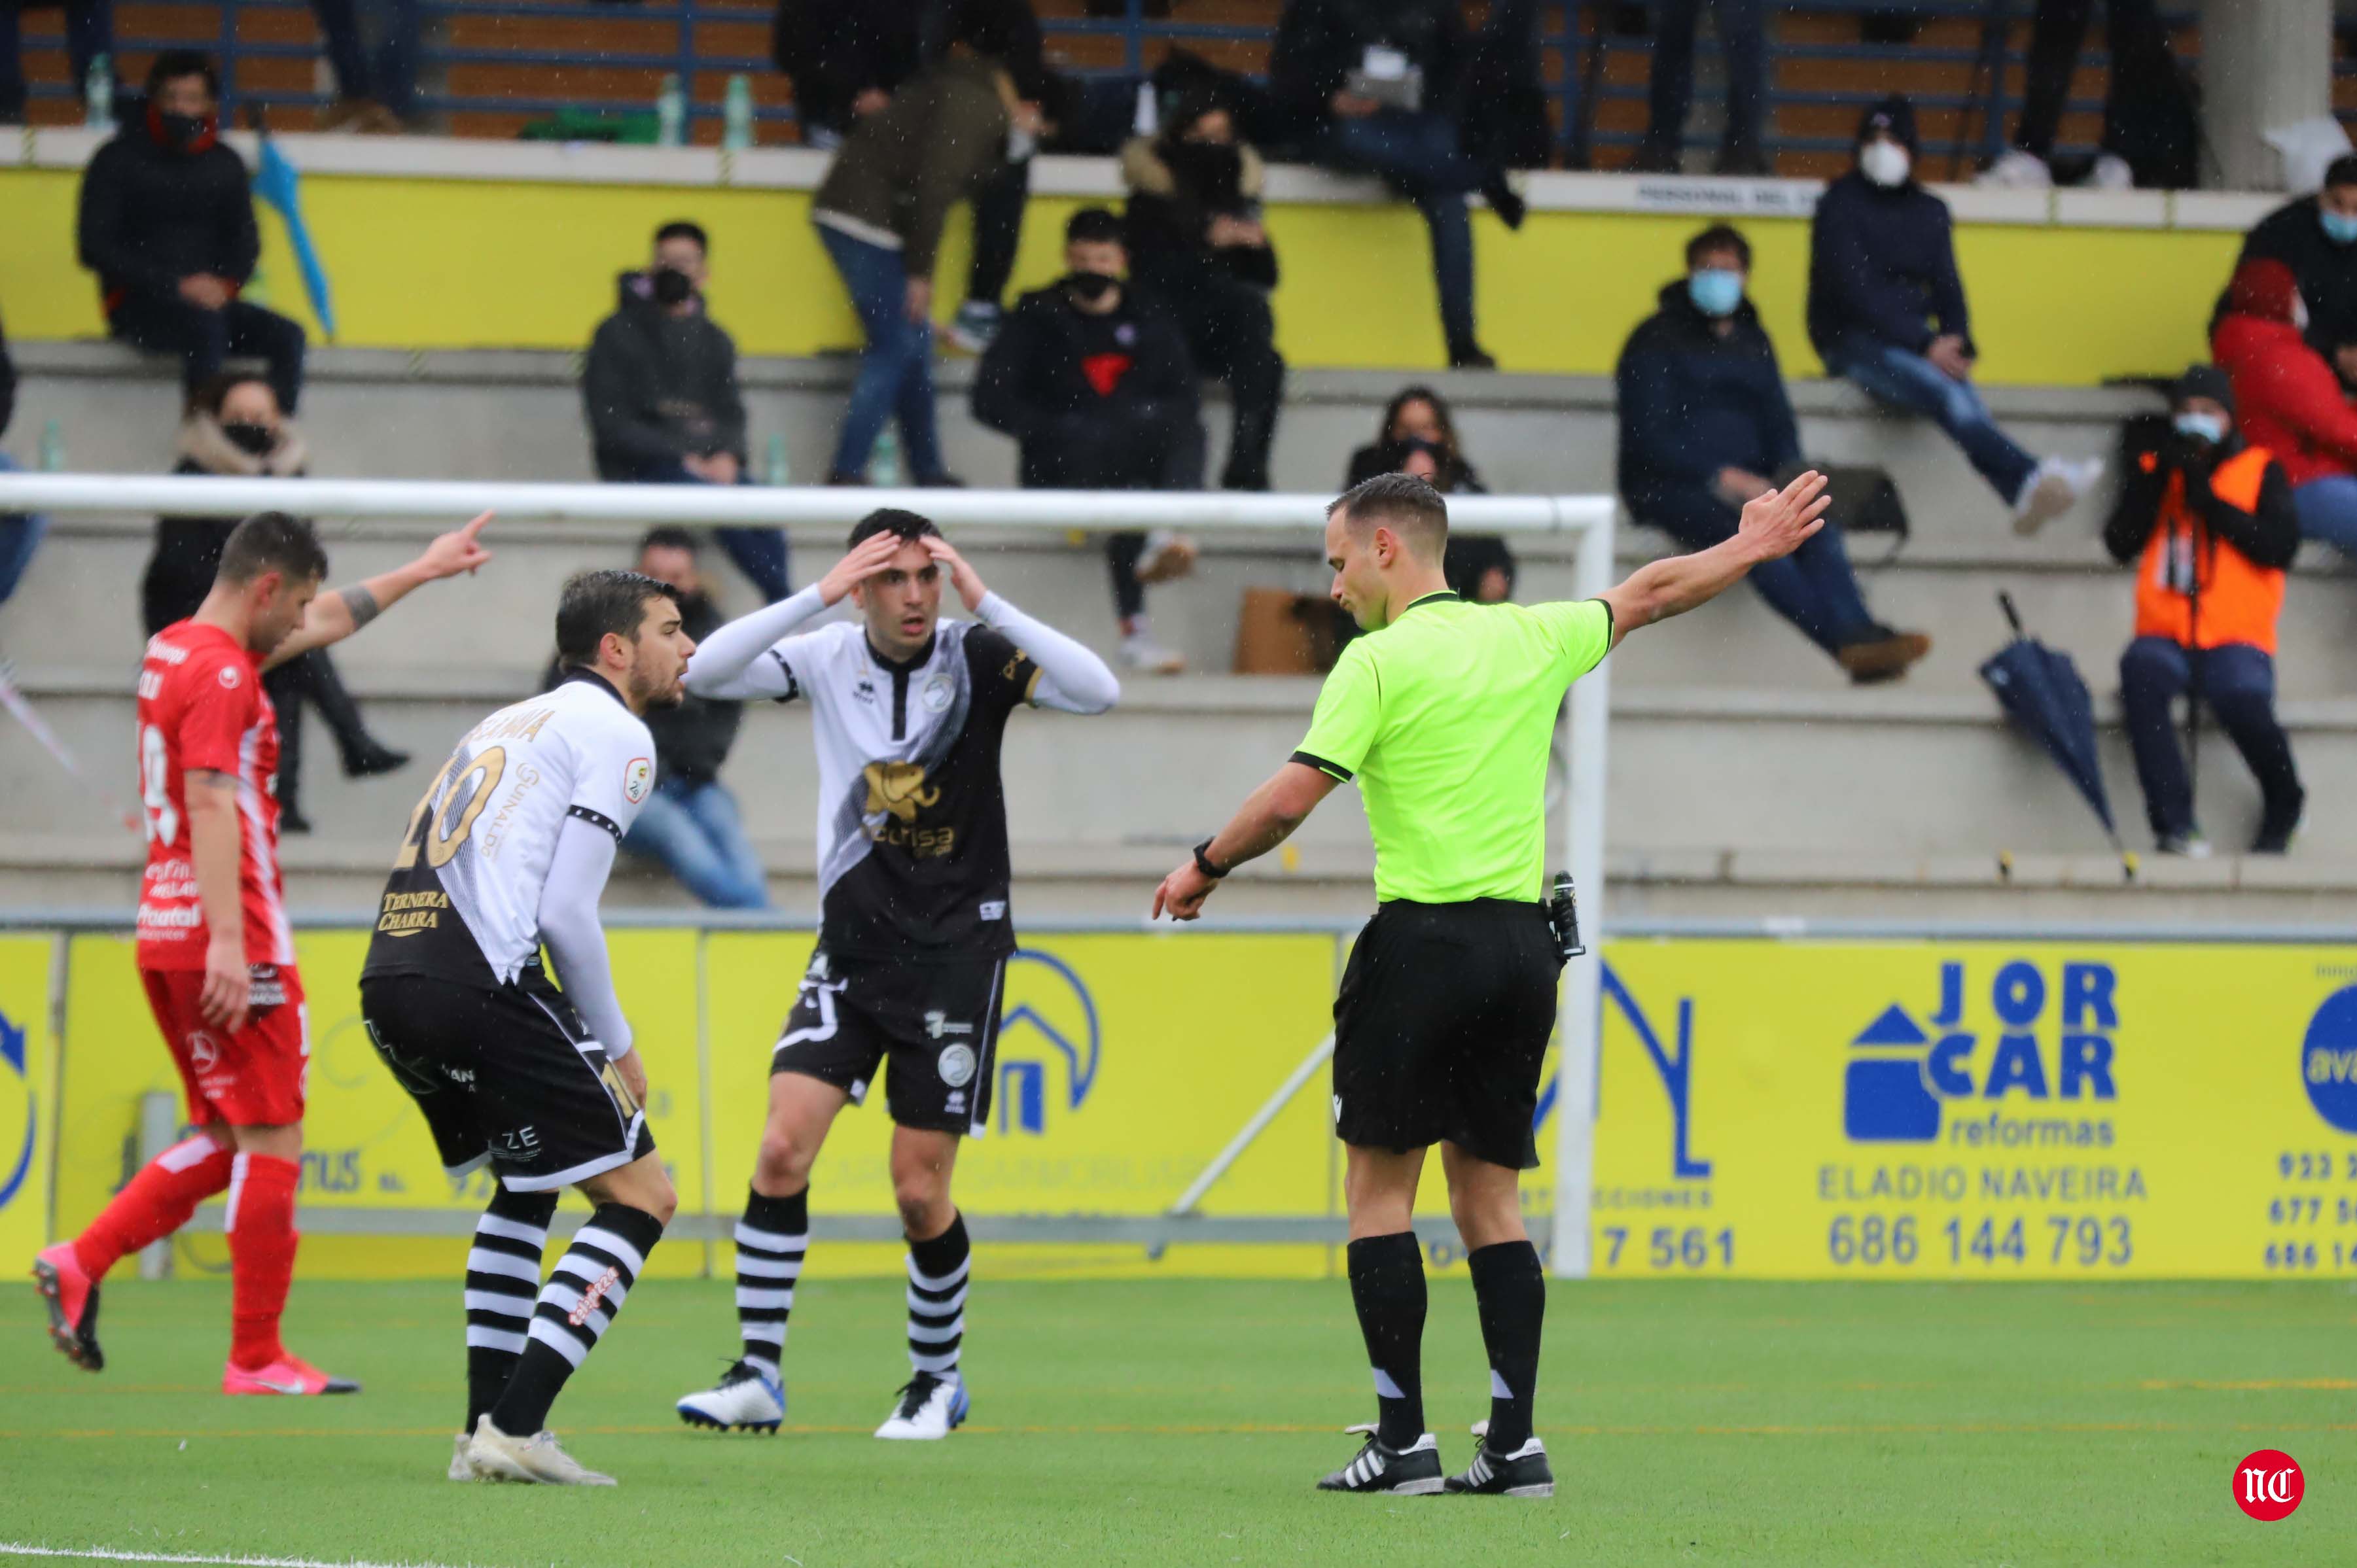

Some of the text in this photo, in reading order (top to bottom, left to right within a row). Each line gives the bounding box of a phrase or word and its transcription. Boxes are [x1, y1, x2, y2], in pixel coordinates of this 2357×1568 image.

[378, 910, 438, 931] CHARRA
[382, 891, 449, 913] TERNERA
[1926, 960, 2119, 1030] JOR
[1926, 1032, 2118, 1101] CAR
[1949, 1111, 2115, 1147] reformas
[1816, 1164, 2148, 1202] ELADIO NAVEIRA
[1650, 1225, 1735, 1268] 561
[1828, 1213, 2134, 1266] 686 144 793
[2263, 1242, 2317, 1270] 686
